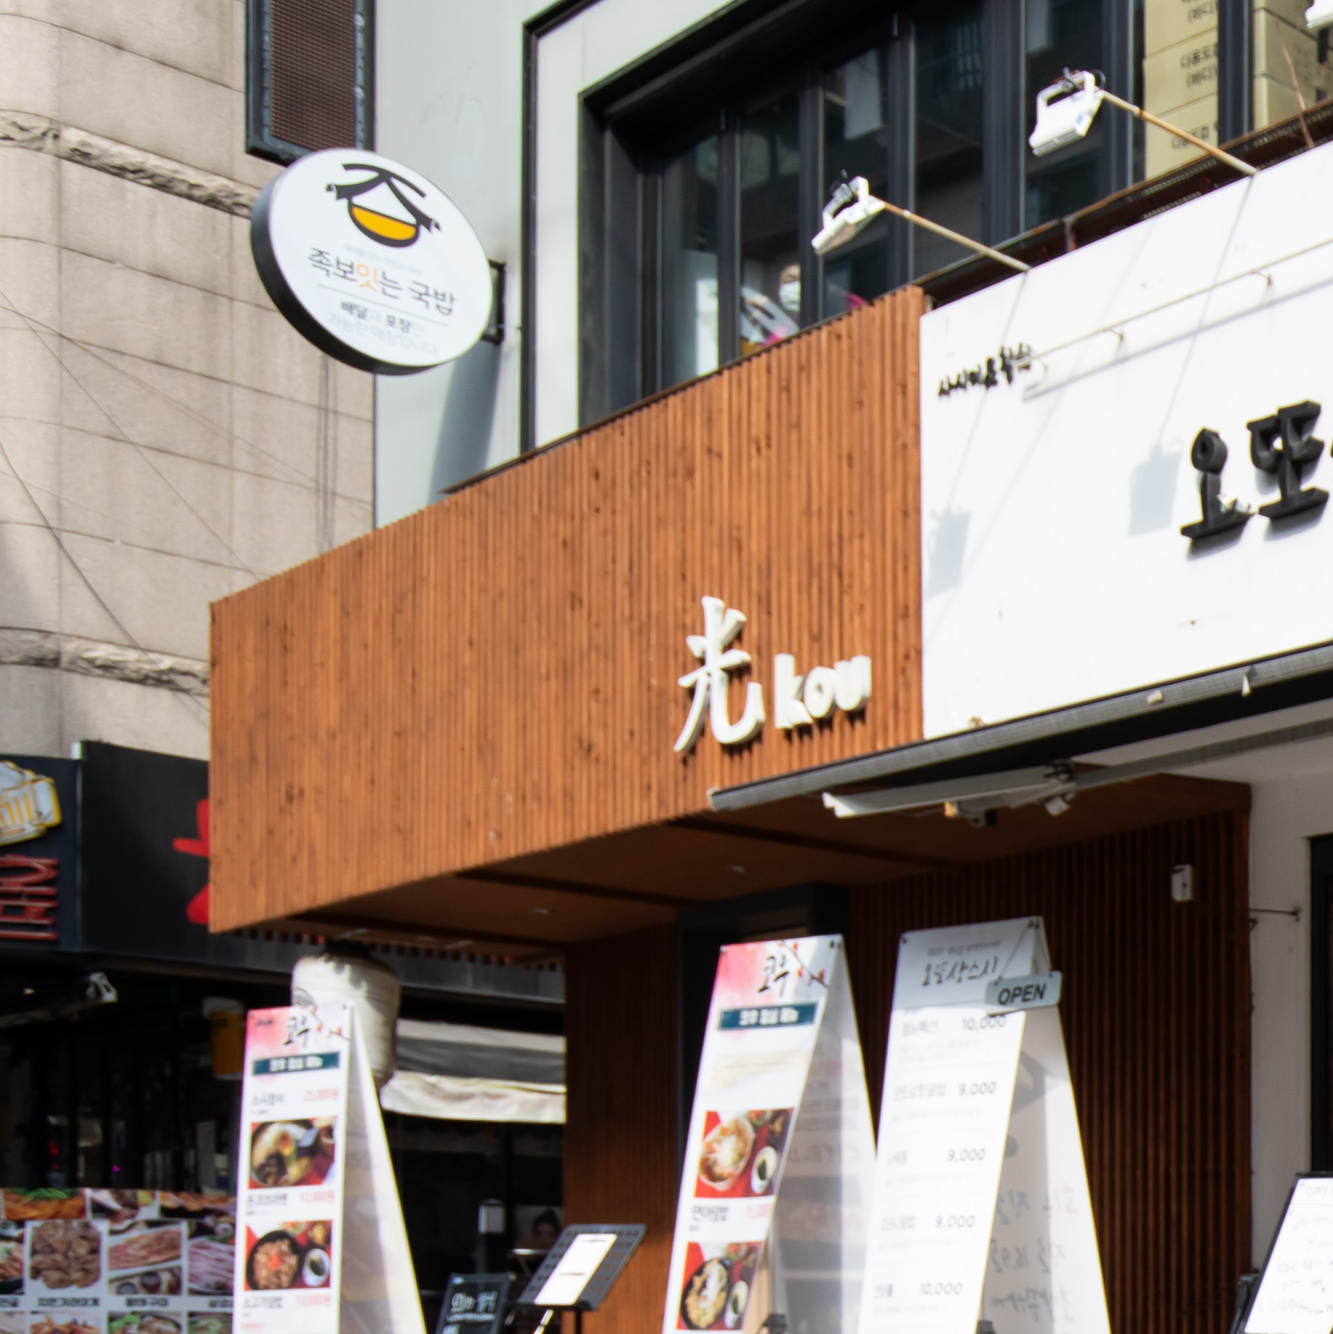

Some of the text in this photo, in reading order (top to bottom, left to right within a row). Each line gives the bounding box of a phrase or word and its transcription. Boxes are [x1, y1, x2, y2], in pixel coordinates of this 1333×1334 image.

[409, 279, 456, 316] 국밥
[997, 983, 1046, 1006] OPEN
[962, 1014, 1006, 1032] 10,000
[957, 1081, 996, 1097] 9,000
[946, 1147, 986, 1162] 9,000
[934, 1214, 975, 1229] 9,000
[919, 1282, 963, 1296] 10,000
